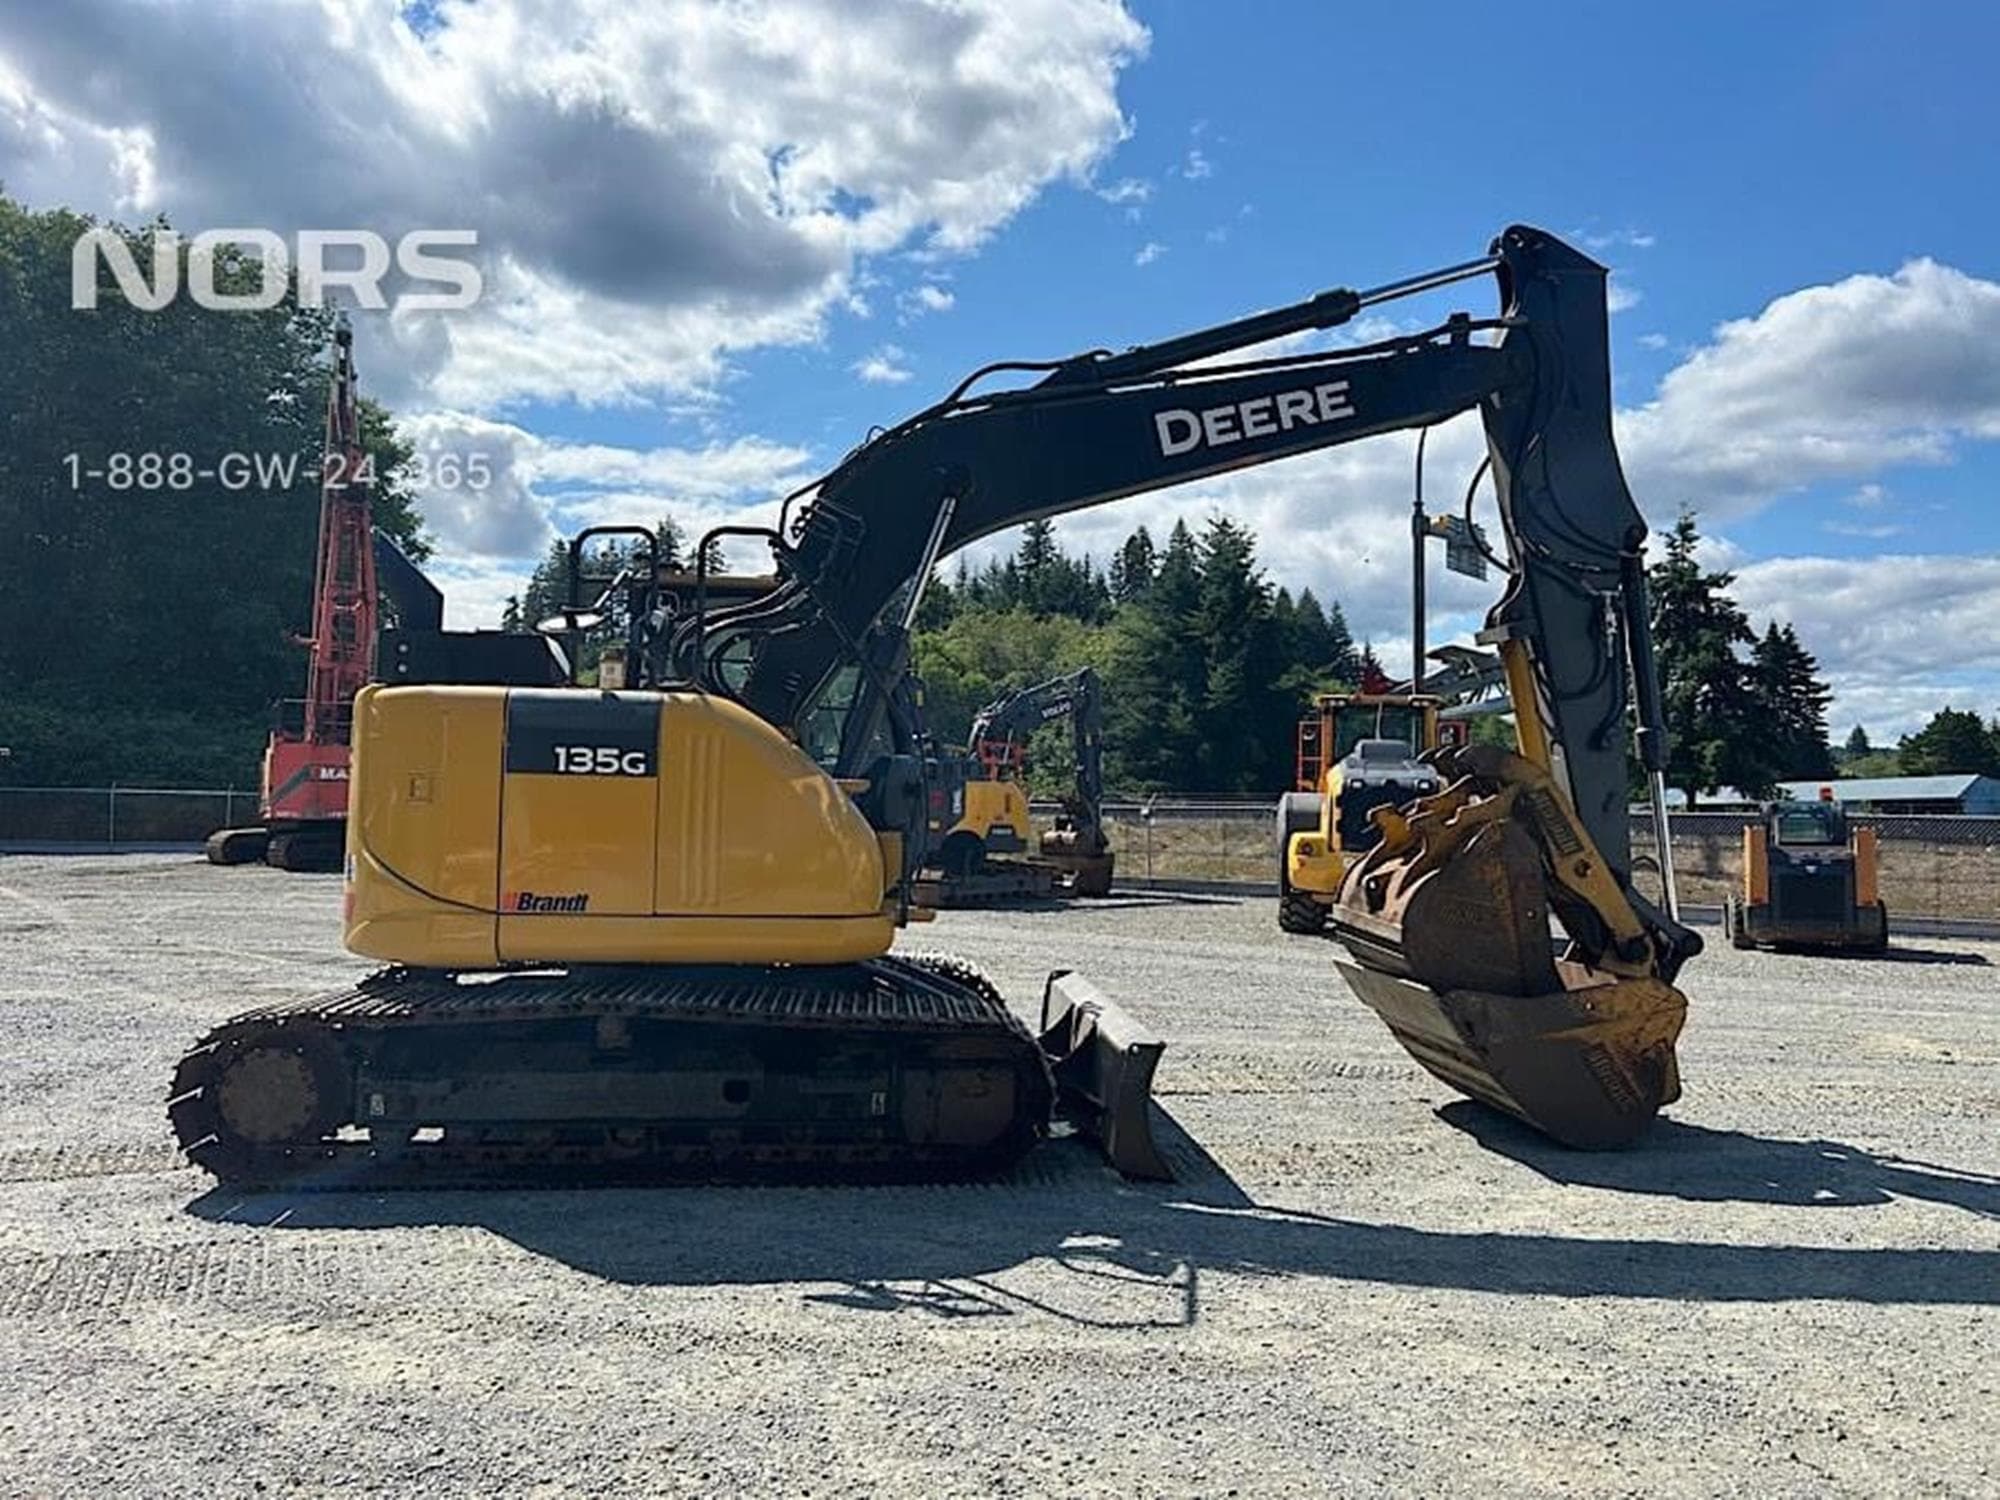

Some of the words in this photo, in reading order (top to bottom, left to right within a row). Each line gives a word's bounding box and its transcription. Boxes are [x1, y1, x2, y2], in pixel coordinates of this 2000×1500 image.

[1154, 381, 1355, 456] DEERE
[554, 746, 646, 775] 135G
[517, 891, 589, 912] Brandt
